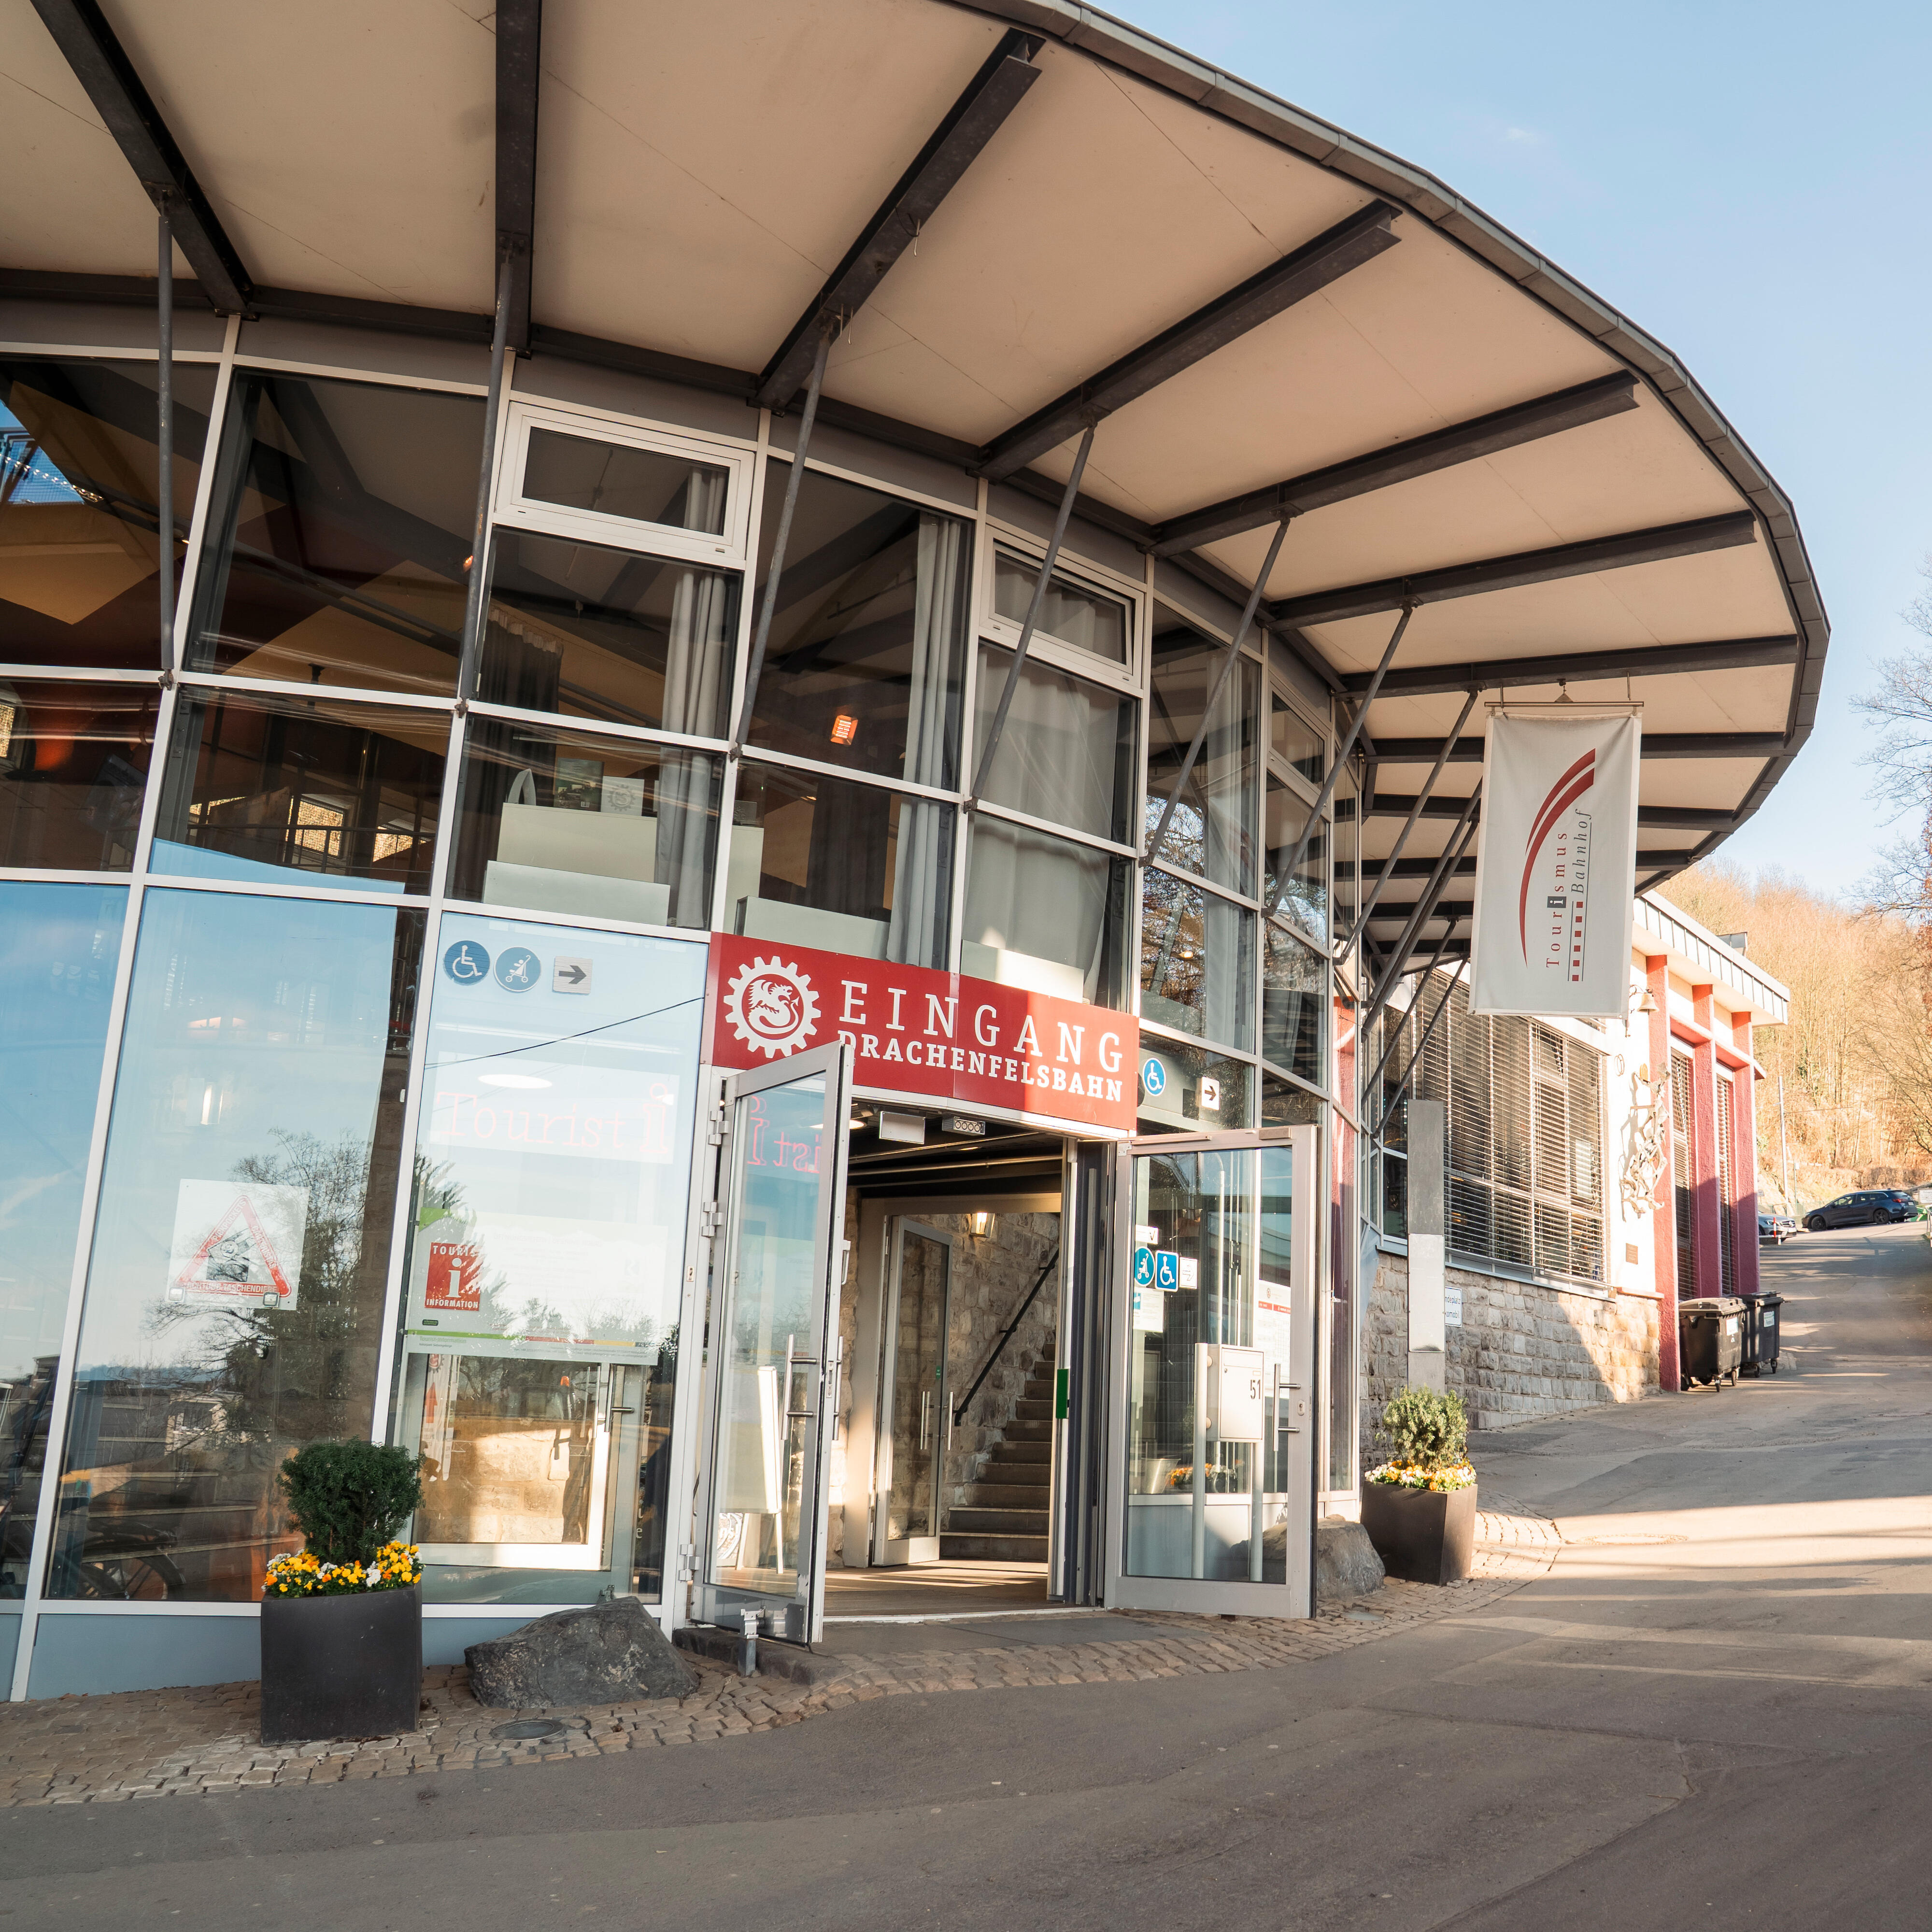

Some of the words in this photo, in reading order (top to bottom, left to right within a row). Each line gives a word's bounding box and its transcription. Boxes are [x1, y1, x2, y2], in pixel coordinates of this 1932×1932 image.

[1571, 809, 1592, 894] Bahnhof
[1545, 832, 1567, 968] Tourismus
[838, 980, 1123, 1073] EINGANG
[837, 1030, 1123, 1102] DRACHENFELSBAHN
[436, 1092, 626, 1149] Tourist
[213, 1199, 247, 1242] PICKPOCKETS
[426, 1298, 479, 1308] INFORMATION
[1250, 1379, 1261, 1400] 51
